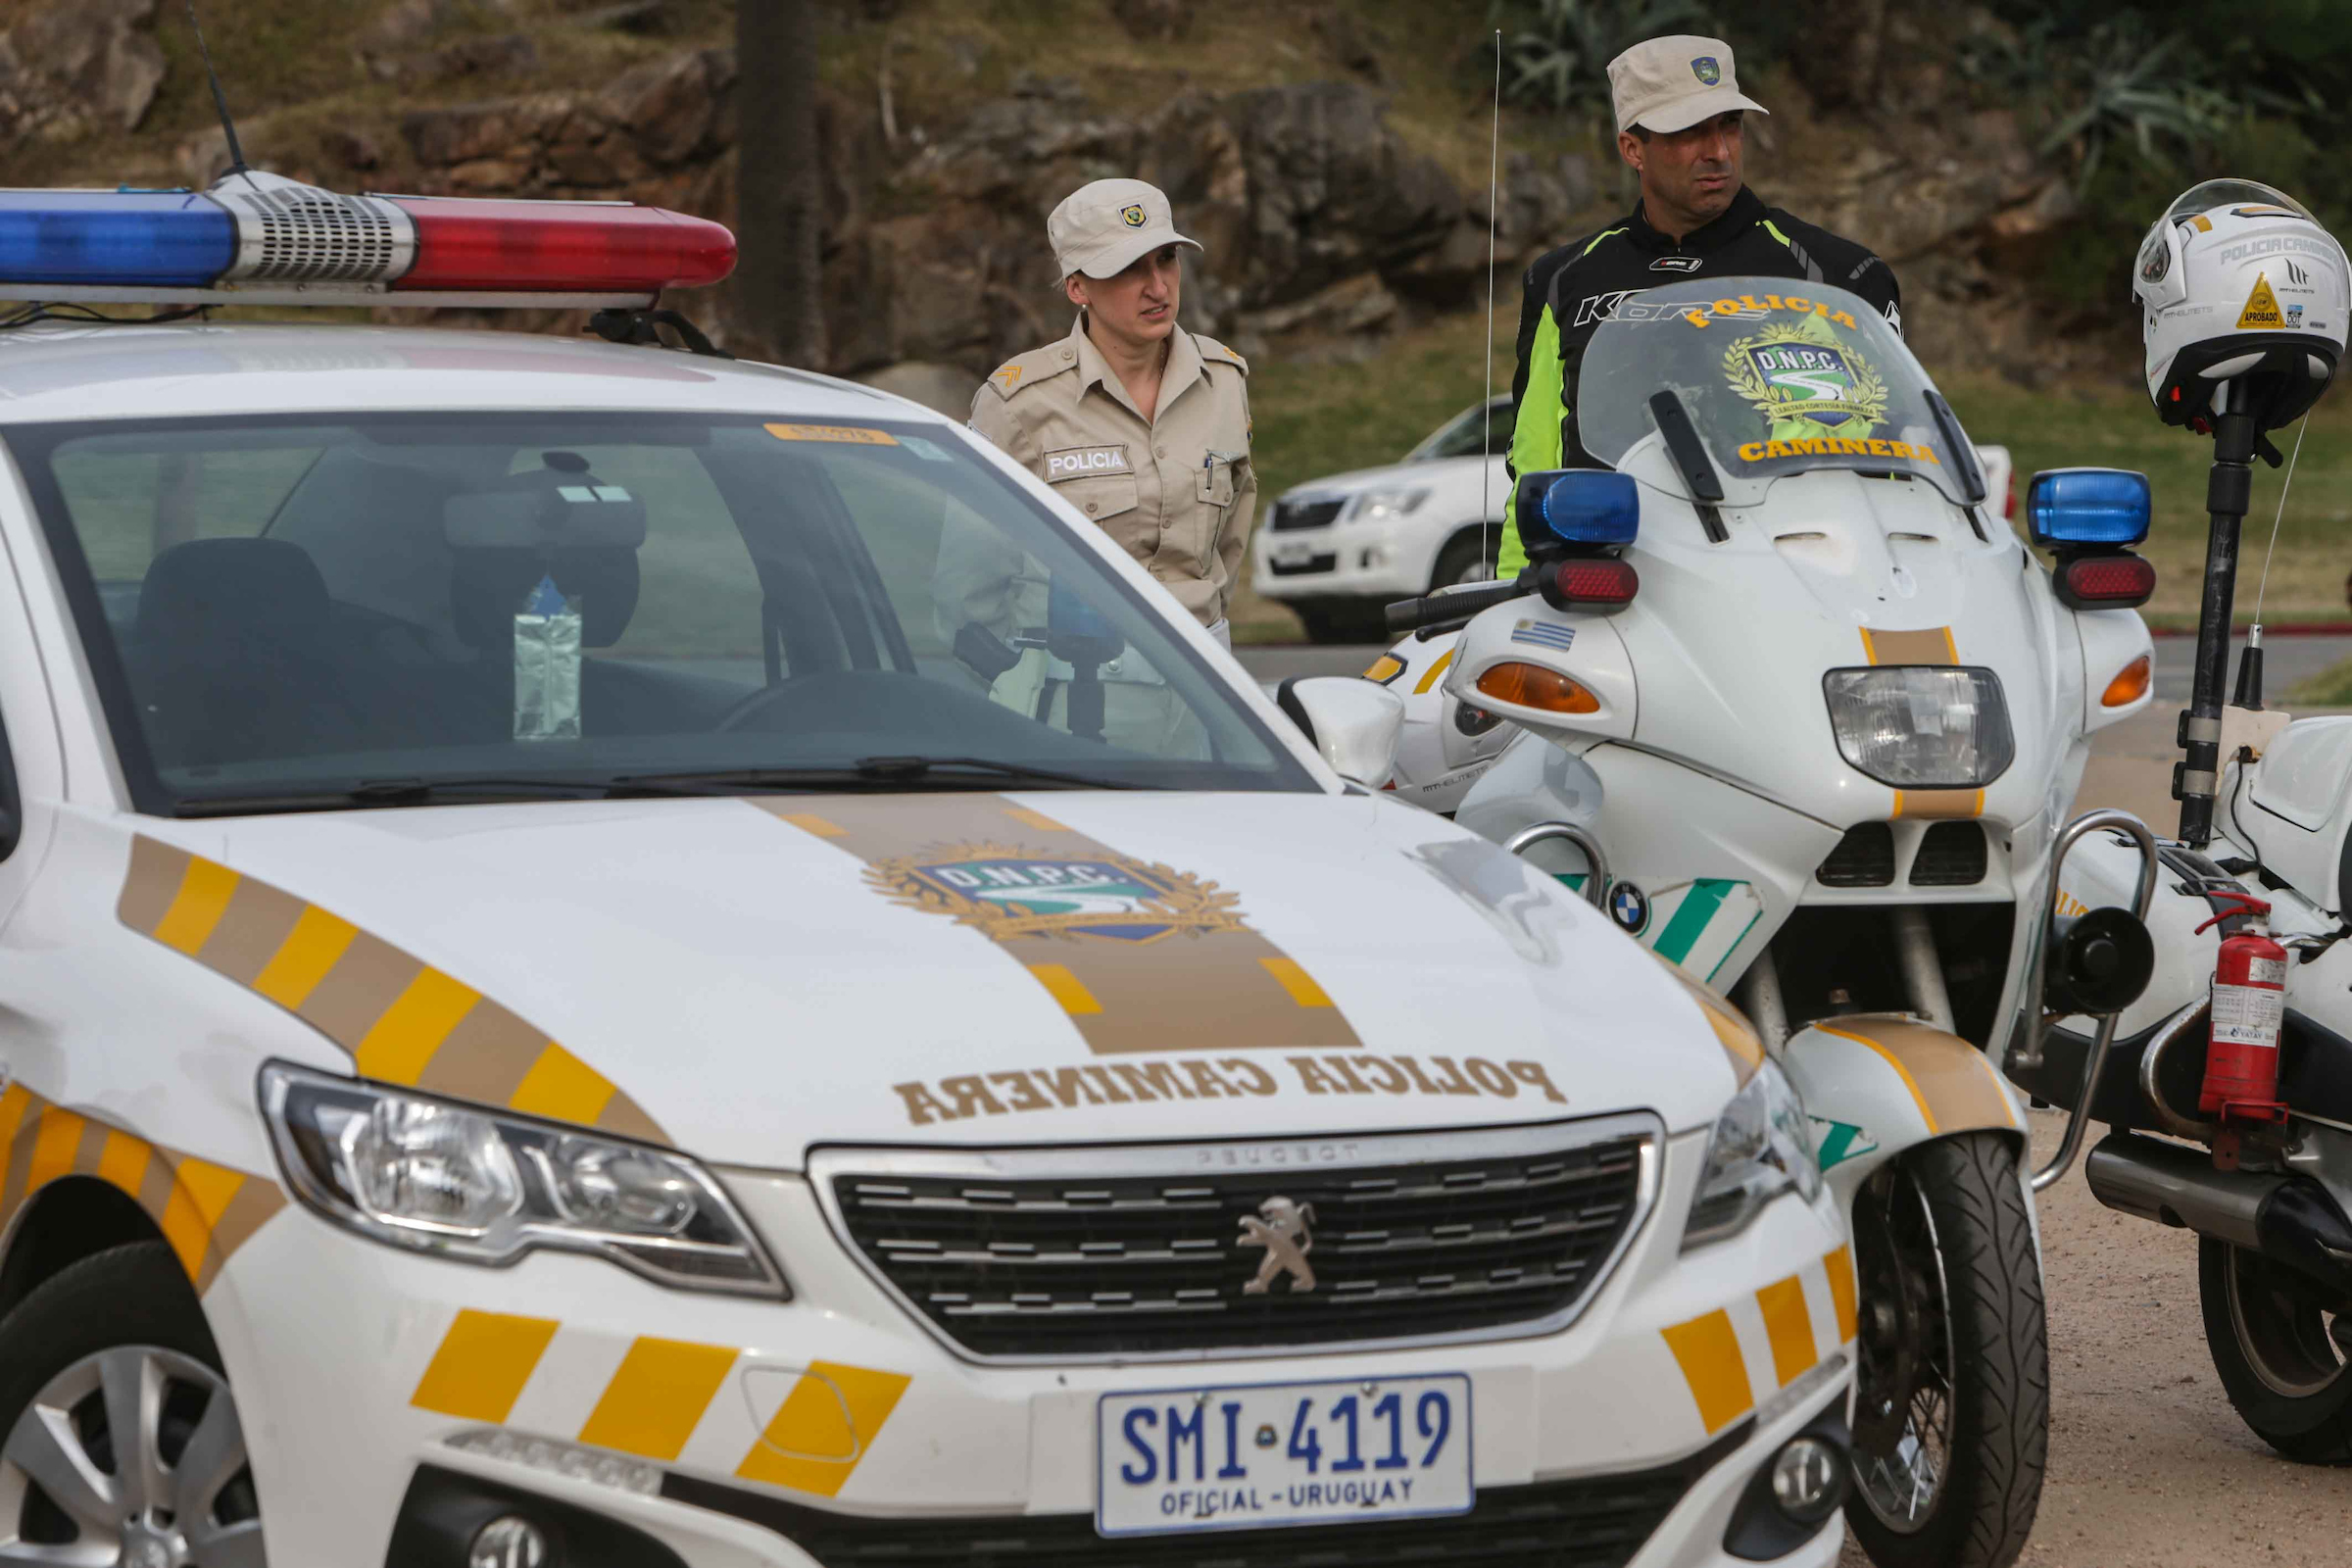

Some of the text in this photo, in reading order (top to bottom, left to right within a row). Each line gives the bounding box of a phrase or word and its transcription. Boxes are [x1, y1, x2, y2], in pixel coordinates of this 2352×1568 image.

[2221, 238, 2282, 266] POLICIA
[1685, 295, 1858, 331] POLICIA
[2244, 312, 2278, 322] APROBADO
[2286, 315, 2301, 324] DOT
[1756, 351, 1844, 372] D.N.P.C.
[1049, 451, 1125, 474] POLICIA
[1738, 437, 1941, 466] CAMINERA
[934, 864, 1128, 888] D.N.P.C.
[1198, 1143, 1359, 1166] PEUGEOT
[1121, 1391, 1451, 1486] SMI 4119
